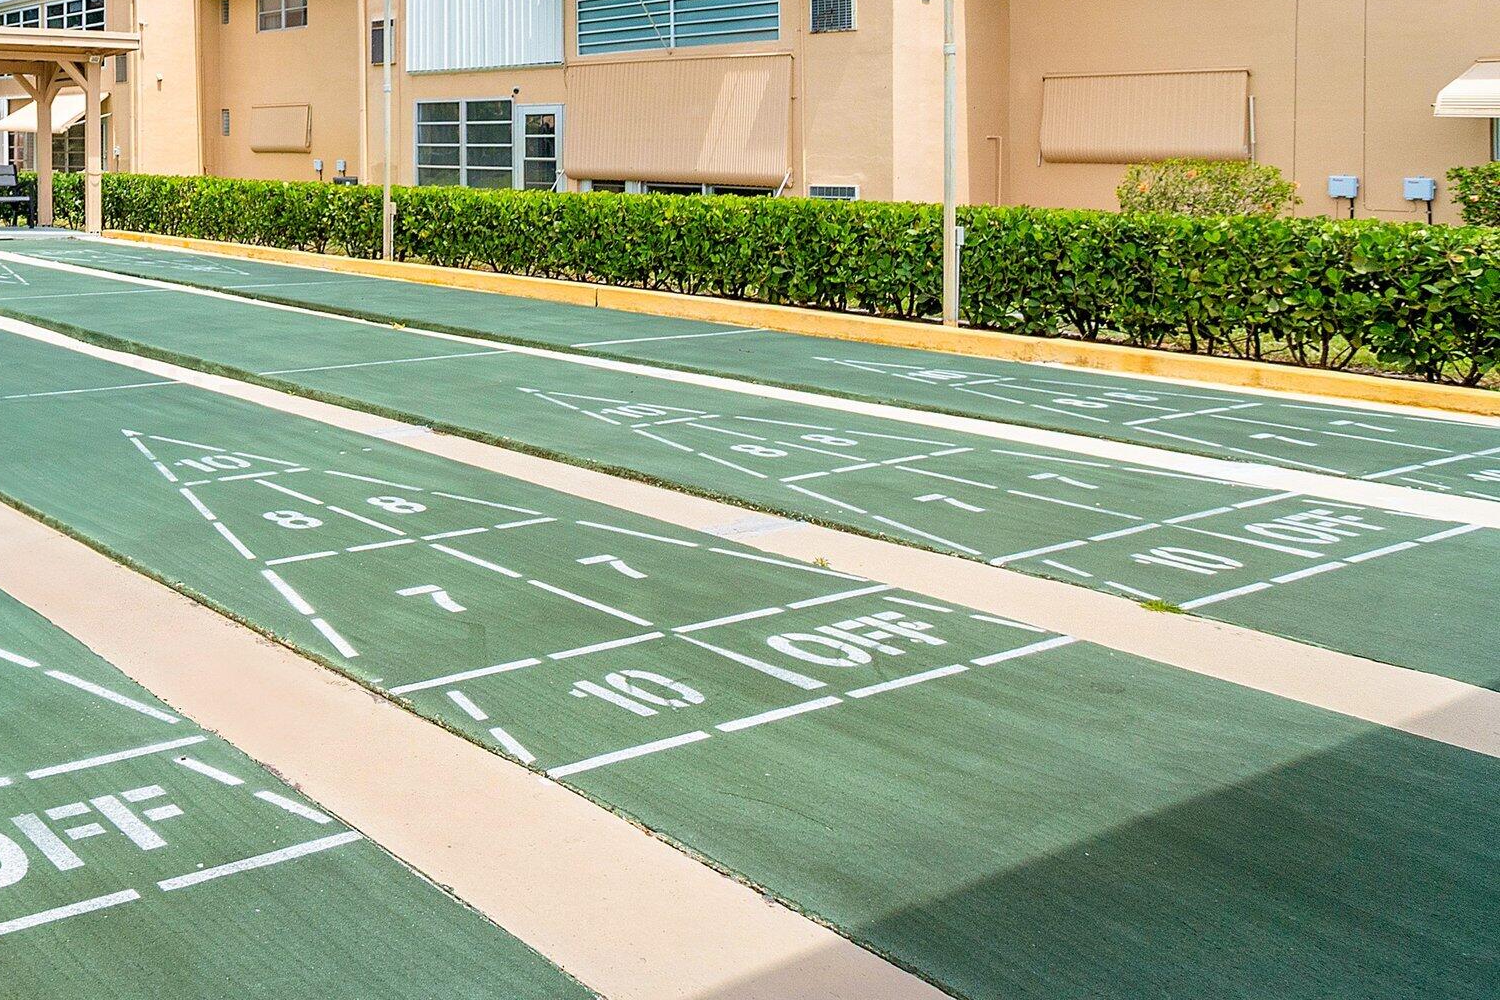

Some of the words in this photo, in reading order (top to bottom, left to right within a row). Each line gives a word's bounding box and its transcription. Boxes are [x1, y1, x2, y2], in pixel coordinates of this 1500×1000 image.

[175, 455, 251, 472] 10
[1027, 472, 1099, 489] 7
[366, 496, 426, 514] 8
[913, 494, 986, 512] 7
[262, 510, 323, 529] 8
[1130, 546, 1243, 575] 10
[1244, 508, 1386, 545] OFF
[576, 554, 648, 579] 7
[396, 584, 467, 612] 7
[569, 669, 706, 717] 10
[767, 611, 947, 667] OFF
